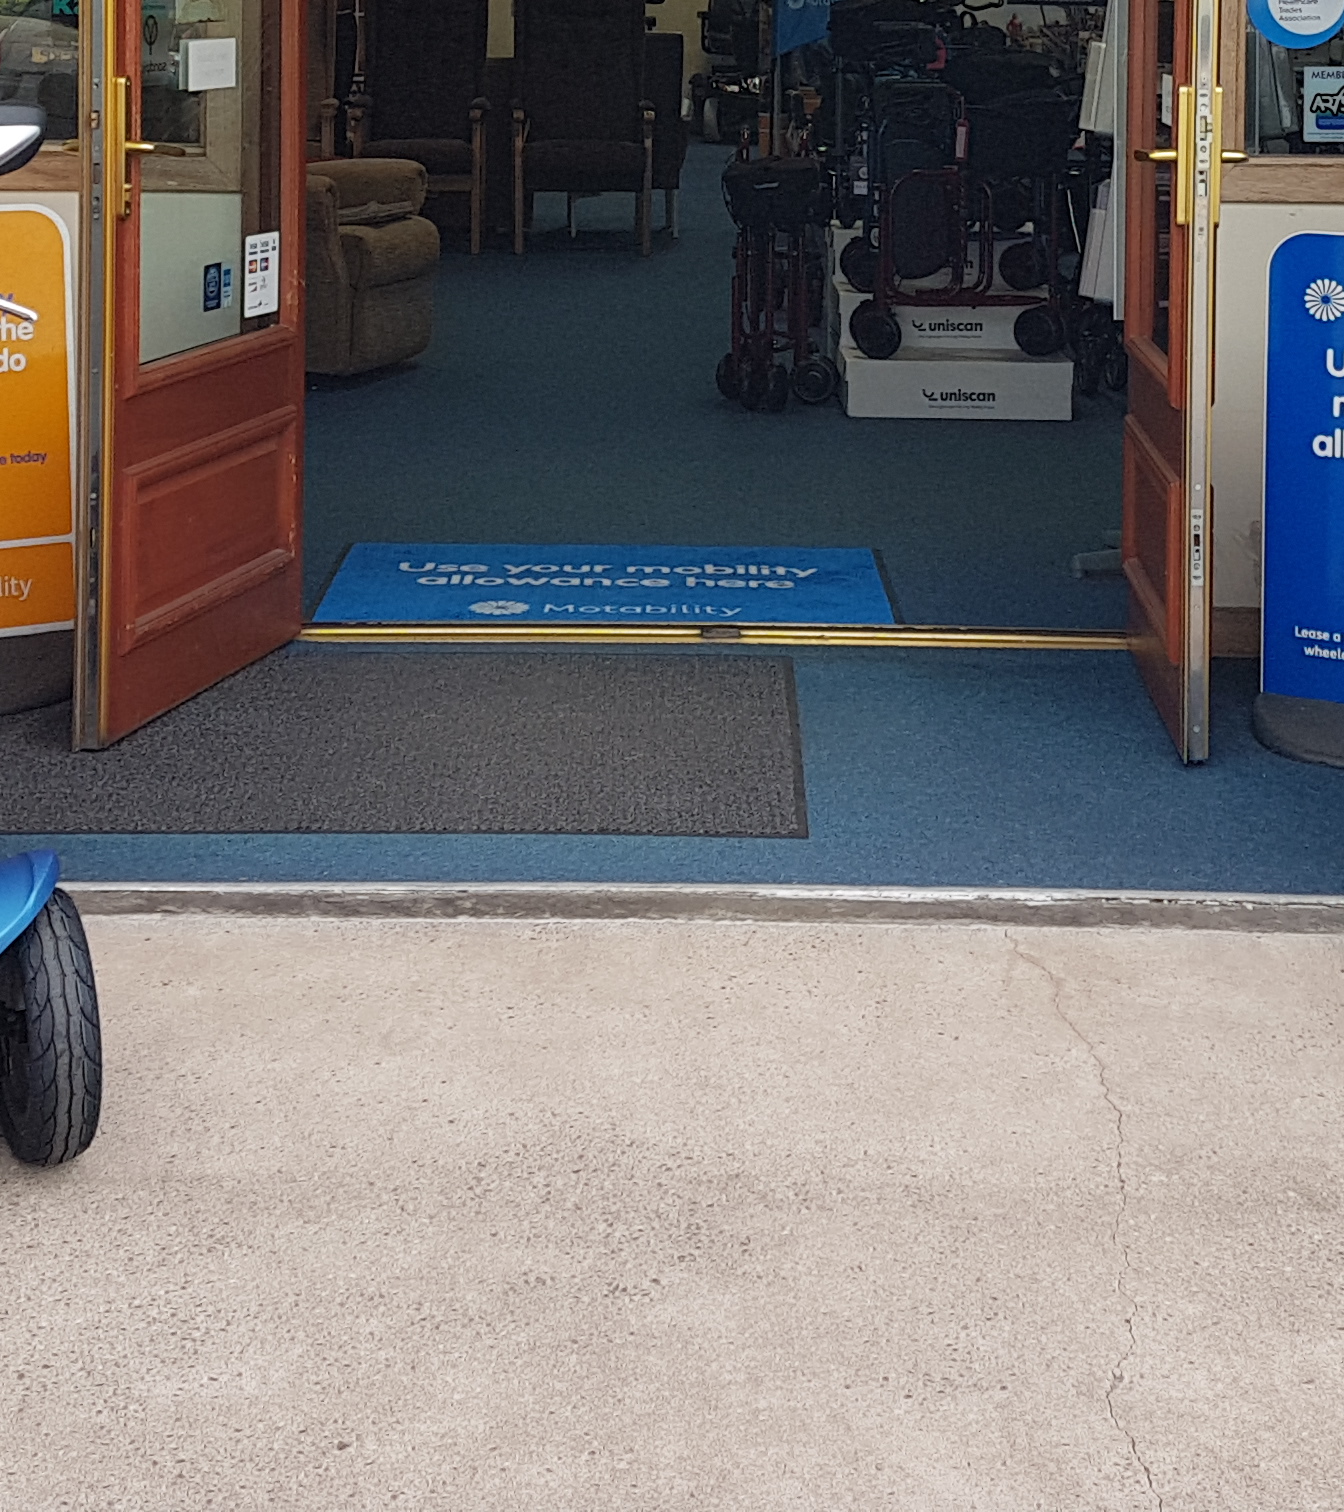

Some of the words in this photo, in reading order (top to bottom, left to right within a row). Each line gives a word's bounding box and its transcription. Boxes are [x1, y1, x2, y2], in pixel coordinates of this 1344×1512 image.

[928, 318, 983, 332] uniscan
[940, 388, 996, 402] uniscan
[10, 450, 47, 464] today
[397, 561, 490, 574] Use
[503, 563, 613, 575] your
[625, 563, 818, 579] mobility
[415, 574, 670, 588] allowance
[685, 576, 795, 589] here
[542, 602, 743, 617] Motability
[1294, 625, 1330, 642] Lease
[1332, 632, 1341, 642] a
